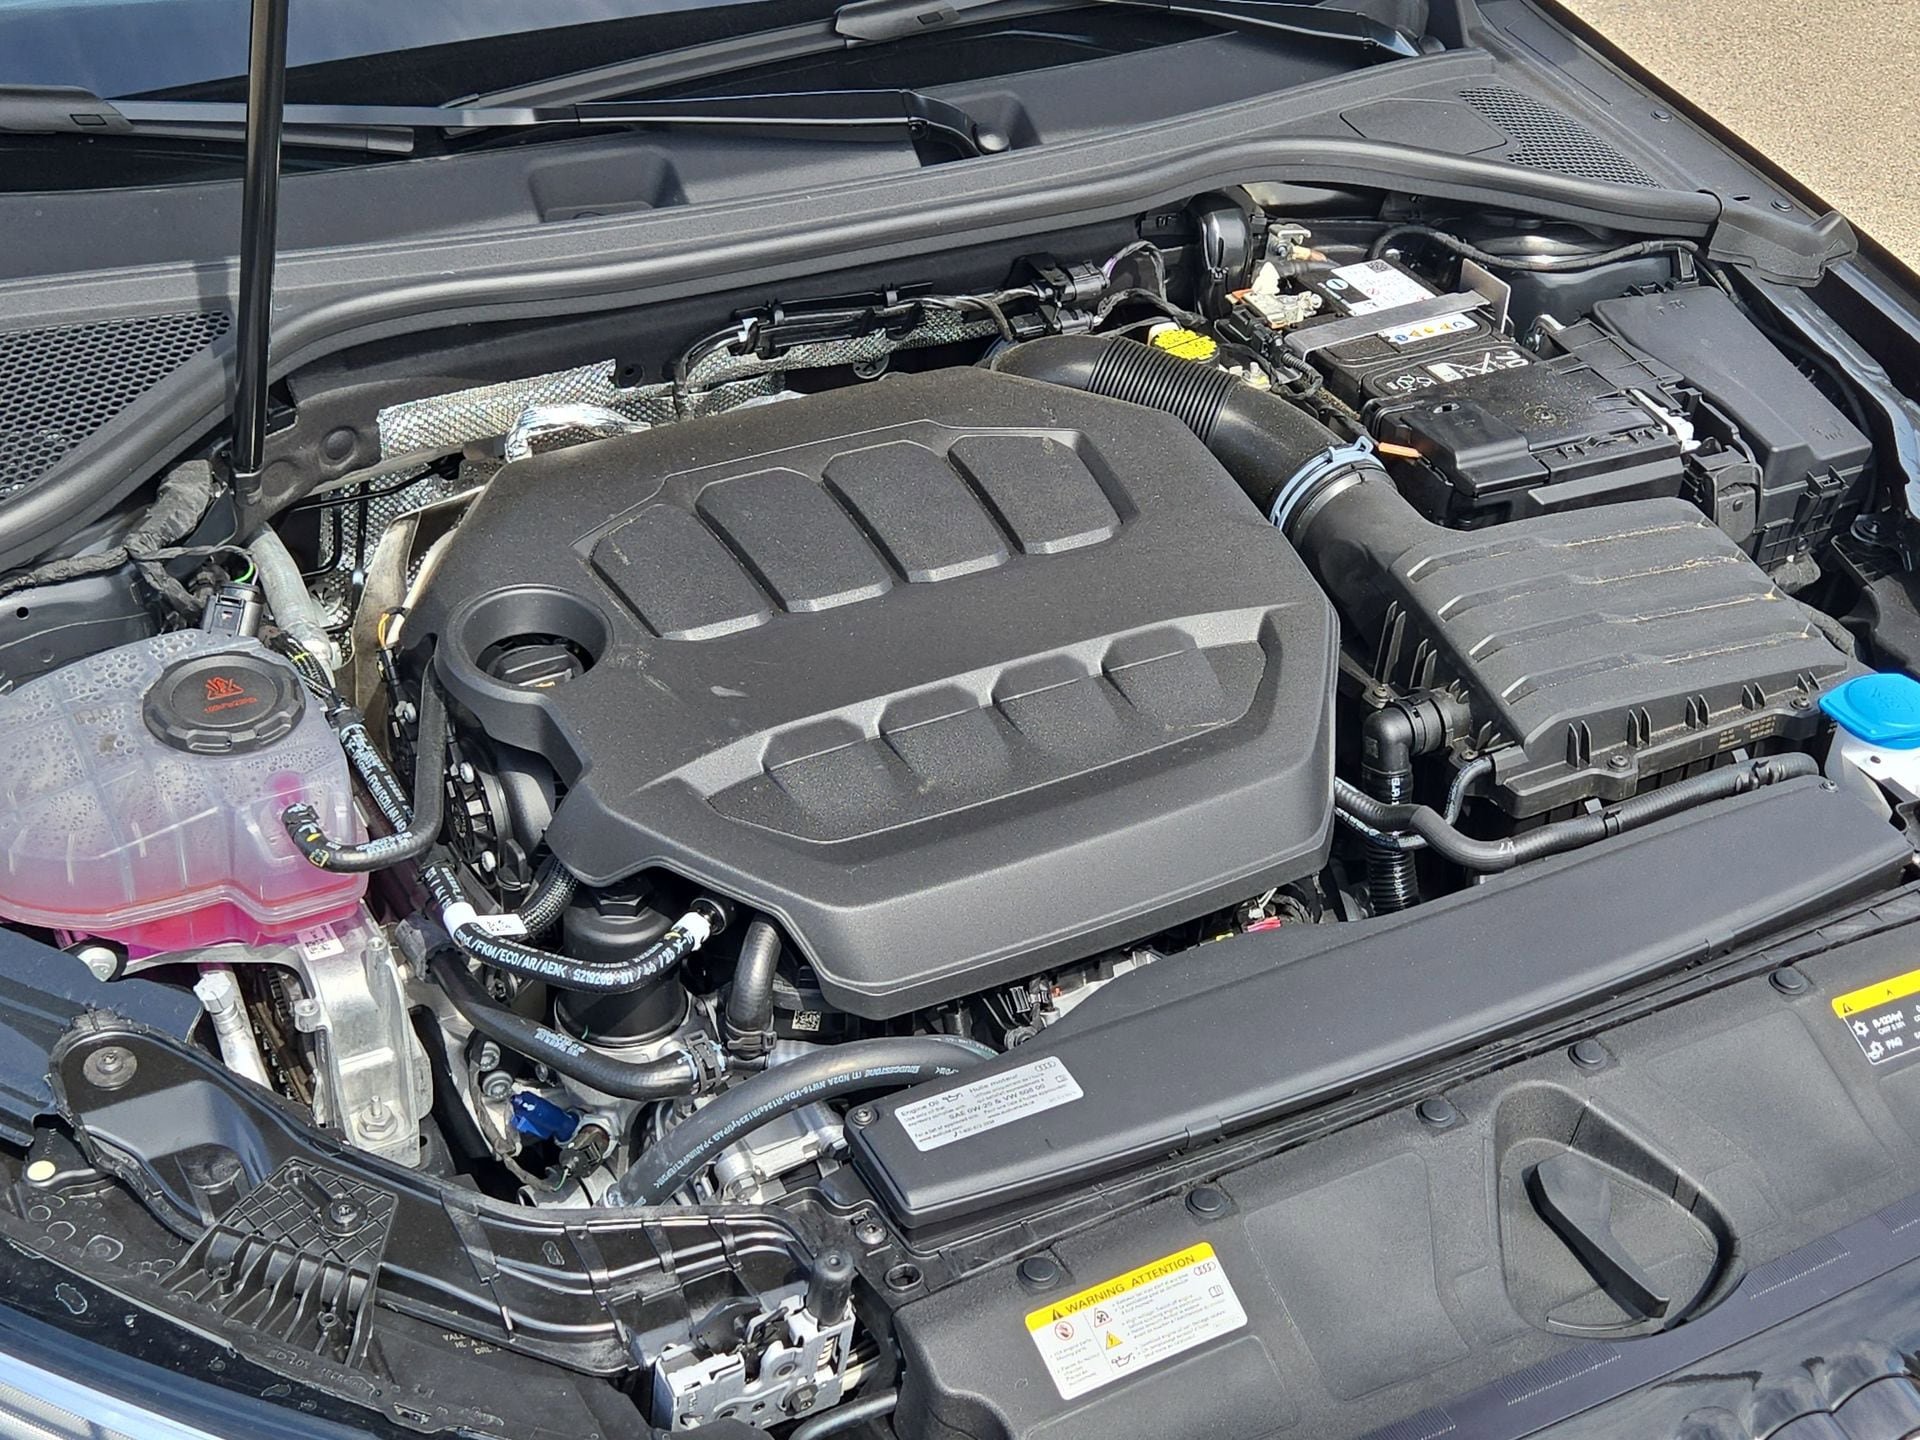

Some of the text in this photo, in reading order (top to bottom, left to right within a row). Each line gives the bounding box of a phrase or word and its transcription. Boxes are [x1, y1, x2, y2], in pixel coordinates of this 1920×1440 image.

[969, 1082, 989, 1093] Huile
[1003, 1091, 1019, 1102] VW
[900, 1098, 940, 1117] Engine Oil
[1065, 1282, 1126, 1314] WARNING
[1130, 1254, 1196, 1288] ATTENTION
